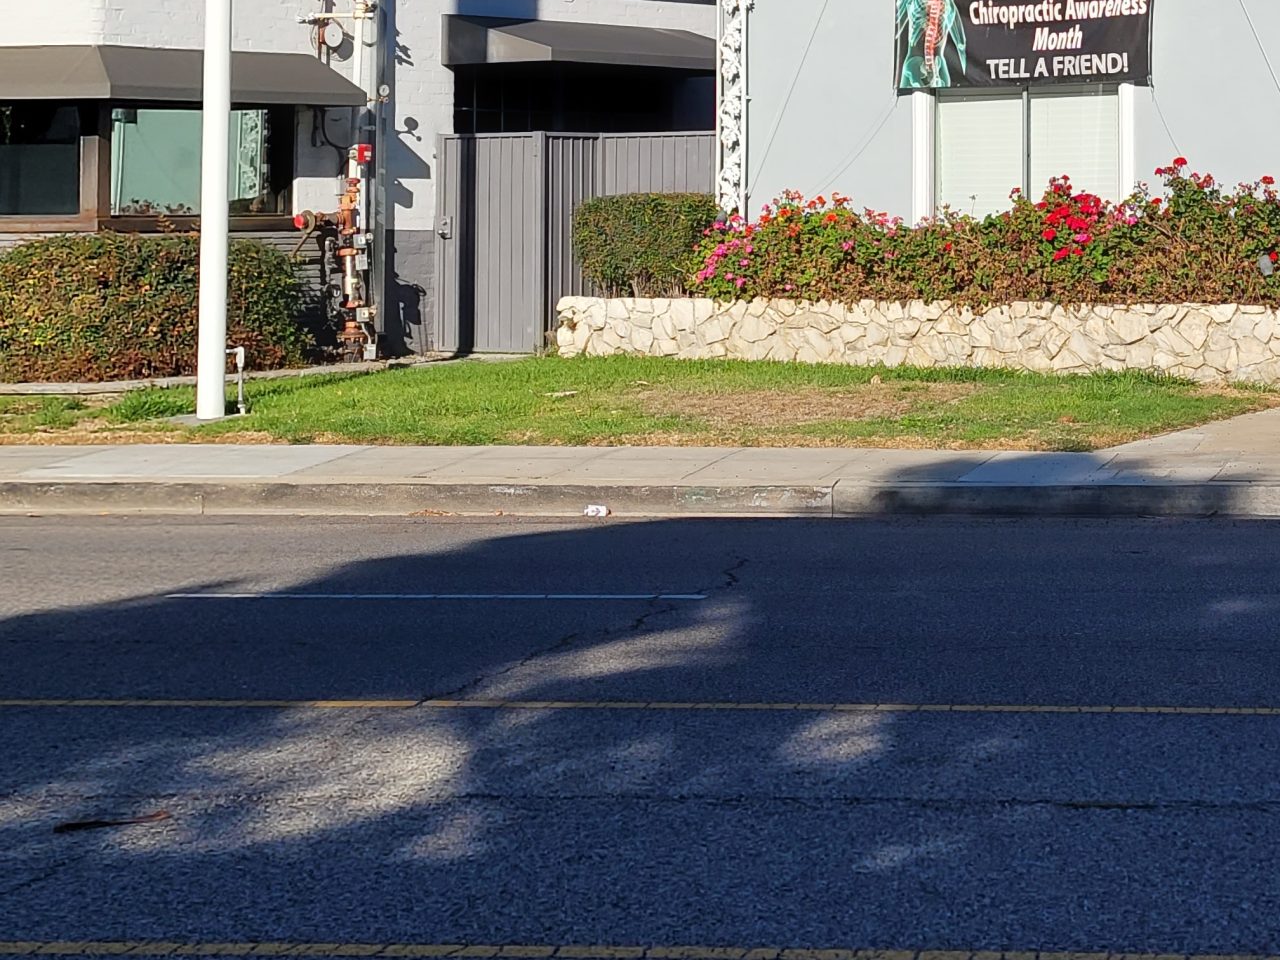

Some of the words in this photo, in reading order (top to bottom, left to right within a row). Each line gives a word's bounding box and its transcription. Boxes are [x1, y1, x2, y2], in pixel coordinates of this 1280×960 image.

[1032, 24, 1083, 52] Month
[986, 58, 1030, 79] TELL
[1033, 57, 1049, 77] A
[1053, 53, 1129, 76] FRIEND!
